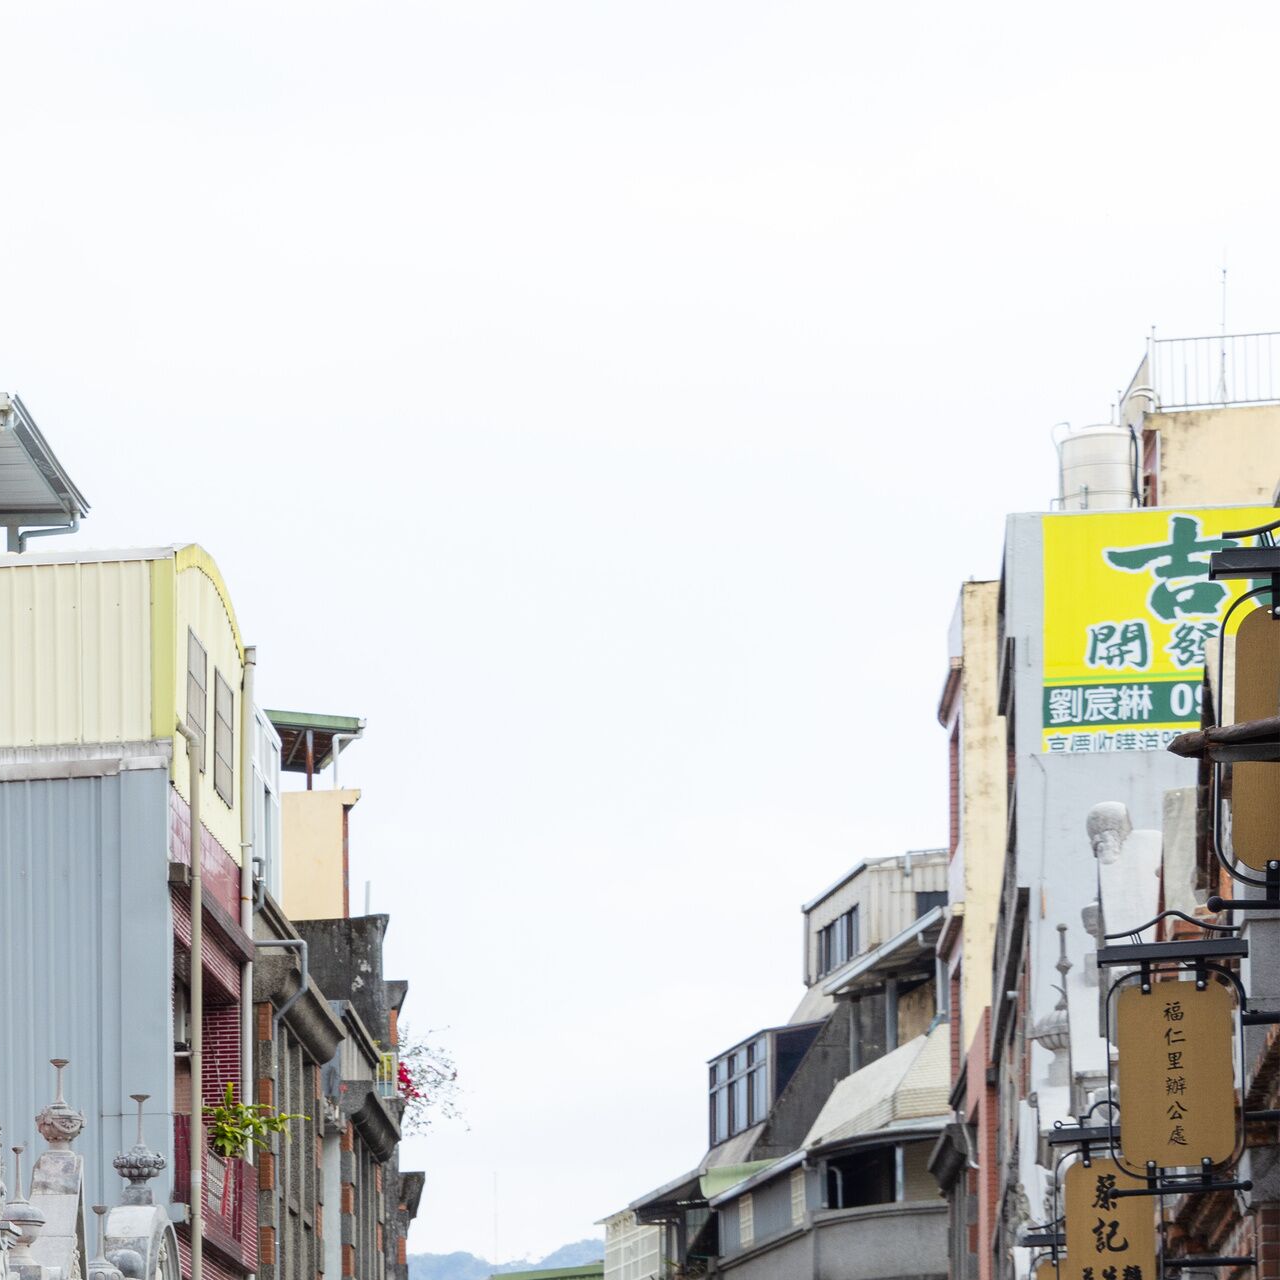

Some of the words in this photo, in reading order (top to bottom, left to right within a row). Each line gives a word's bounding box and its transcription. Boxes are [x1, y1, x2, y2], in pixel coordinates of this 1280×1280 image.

[1163, 1001, 1190, 1147] 福仁里辦公處
[1091, 1173, 1130, 1254] 蔡記
